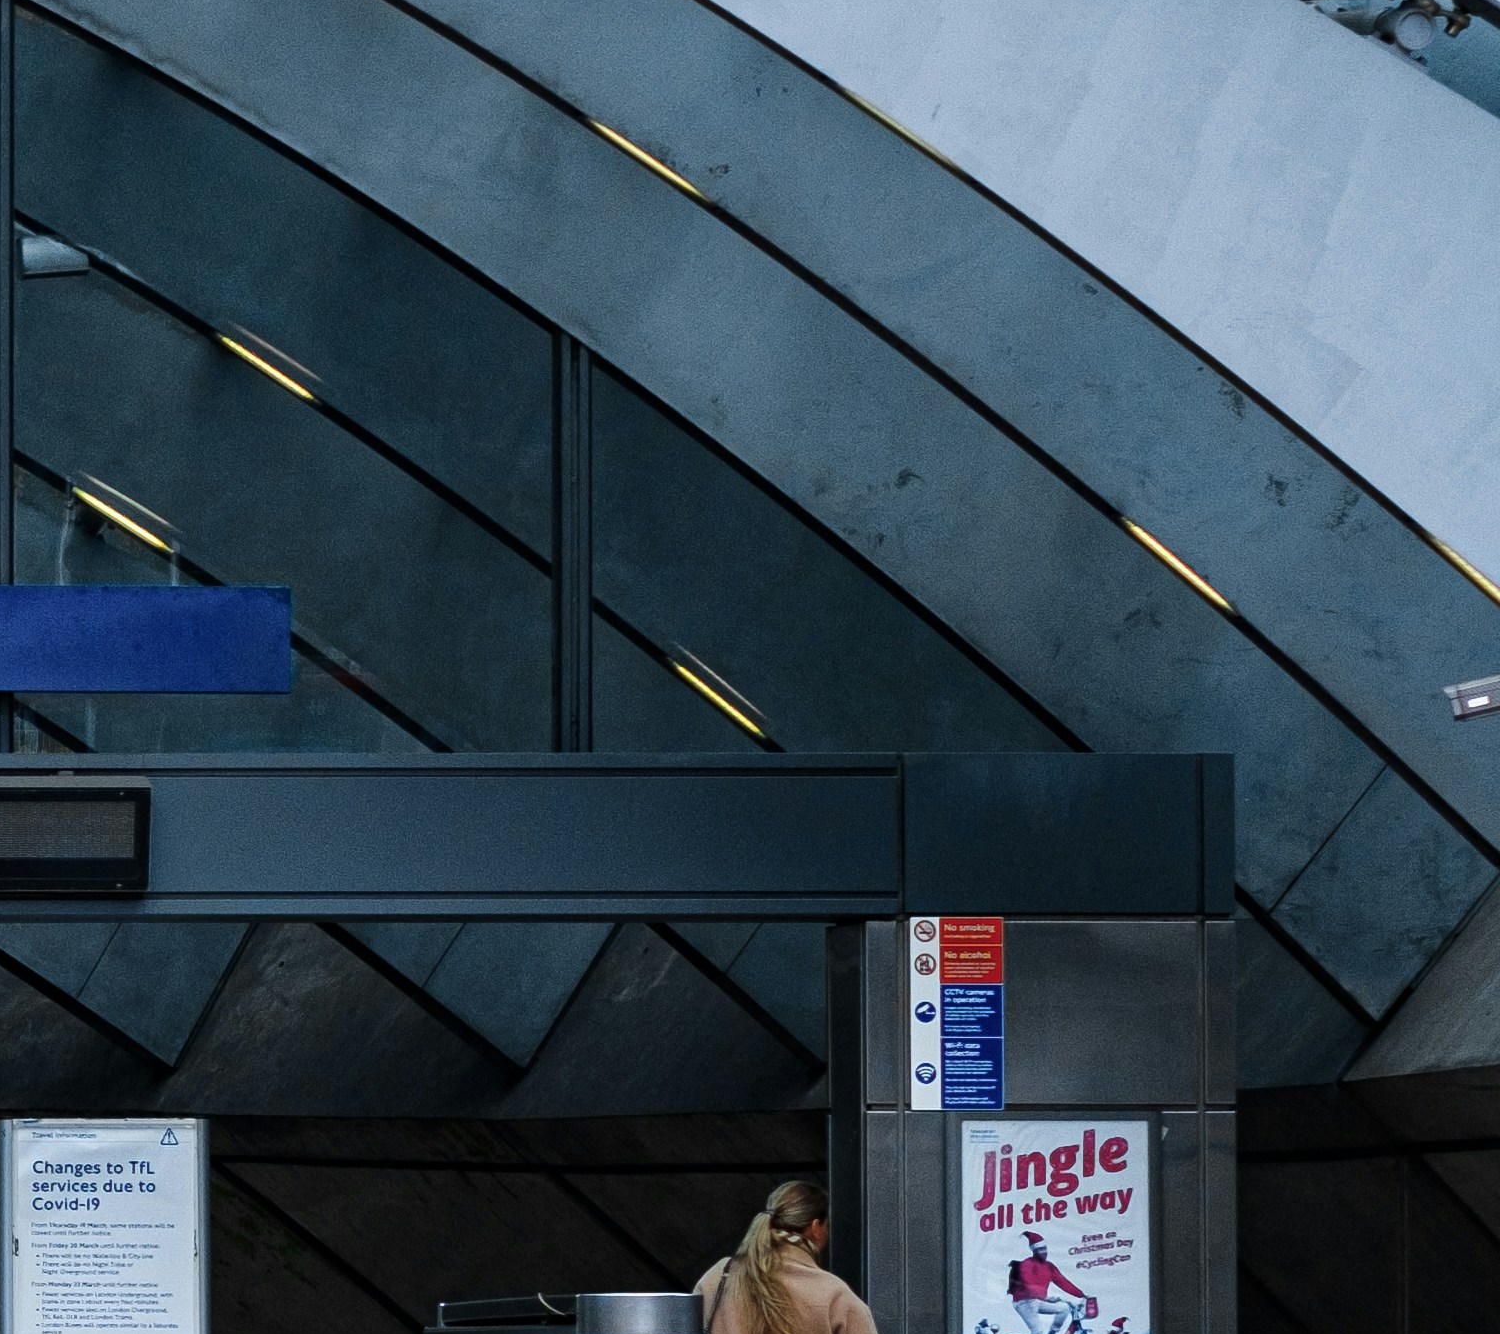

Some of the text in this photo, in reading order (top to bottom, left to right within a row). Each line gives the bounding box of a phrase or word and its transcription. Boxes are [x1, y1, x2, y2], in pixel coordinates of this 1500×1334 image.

[959, 924, 996, 933] smoking
[944, 951, 991, 959] No alcohol
[32, 1160, 155, 1177] Changes to TfL
[31, 1179, 156, 1192] services due to
[32, 1197, 100, 1211] Covid-19
[980, 1187, 1133, 1232] all the way
[1081, 1231, 1117, 1243] Even on
[1068, 1239, 1134, 1255] Christmas Day
